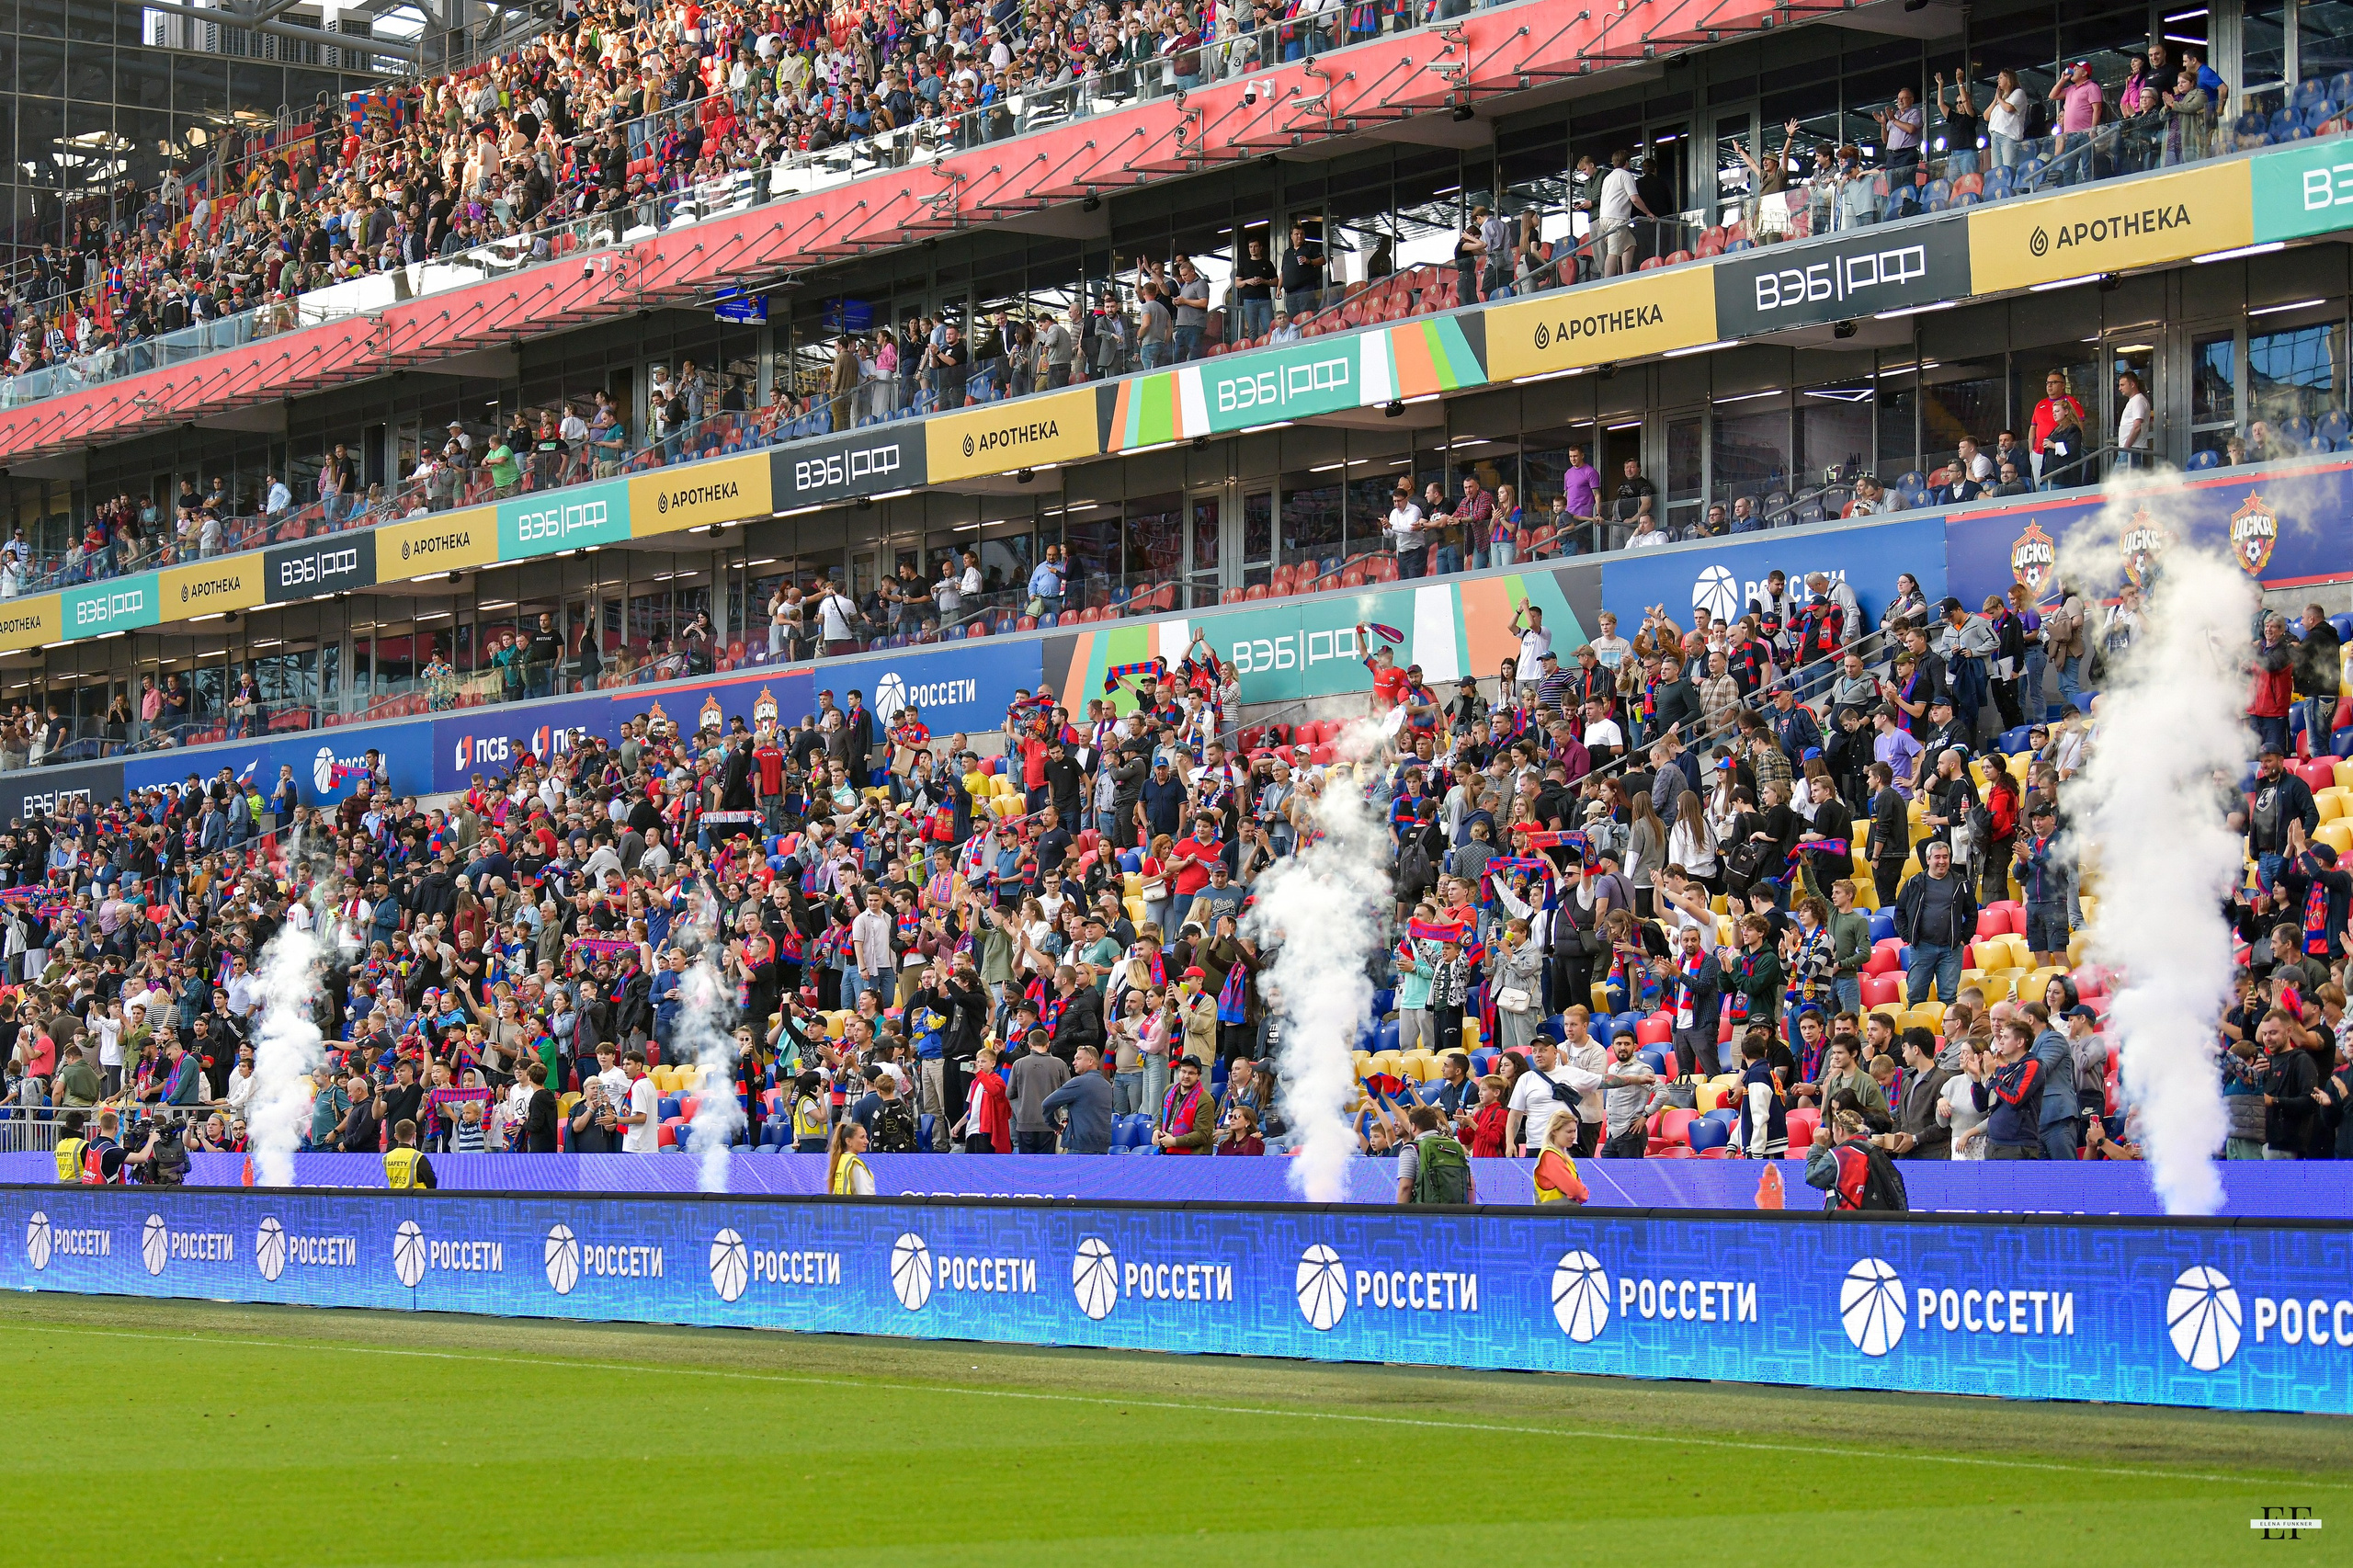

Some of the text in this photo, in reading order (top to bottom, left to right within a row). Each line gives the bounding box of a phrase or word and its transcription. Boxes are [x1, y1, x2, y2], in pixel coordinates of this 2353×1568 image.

[2056, 204, 2191, 249] APOTHEKA
[1556, 304, 1664, 342] APOTHEKA
[979, 420, 1059, 451] APOTHEKA
[672, 481, 739, 508] APOTHEKA
[414, 531, 471, 555] APOTHEKA
[2233, 515, 2274, 540] ЦСКА
[2014, 543, 2052, 569] ЦСКА
[191, 576, 241, 597] APOTHEKA
[909, 678, 975, 707] РОССЕТИ
[701, 710, 720, 728] ЦСКА
[756, 703, 776, 722] ЦСКА
[476, 736, 508, 764] ПСБ
[54, 1229, 110, 1256] РОССЕТИ
[171, 1232, 233, 1261] РОССЕТИ
[290, 1235, 356, 1267] РОССЕТИ
[430, 1240, 503, 1272] РОССЕТИ
[584, 1244, 664, 1278] РОССЕТИ
[754, 1250, 841, 1285] РОССЕТИ
[938, 1256, 1037, 1293] РОССЕТИ
[1124, 1262, 1233, 1301] РОССЕТИ
[1355, 1269, 1478, 1312] РОССЕТИ
[1619, 1278, 1757, 1323] РОССЕТИ
[1917, 1287, 2075, 1335] РОССЕТИ
[2255, 1297, 2353, 1346] РОСС
